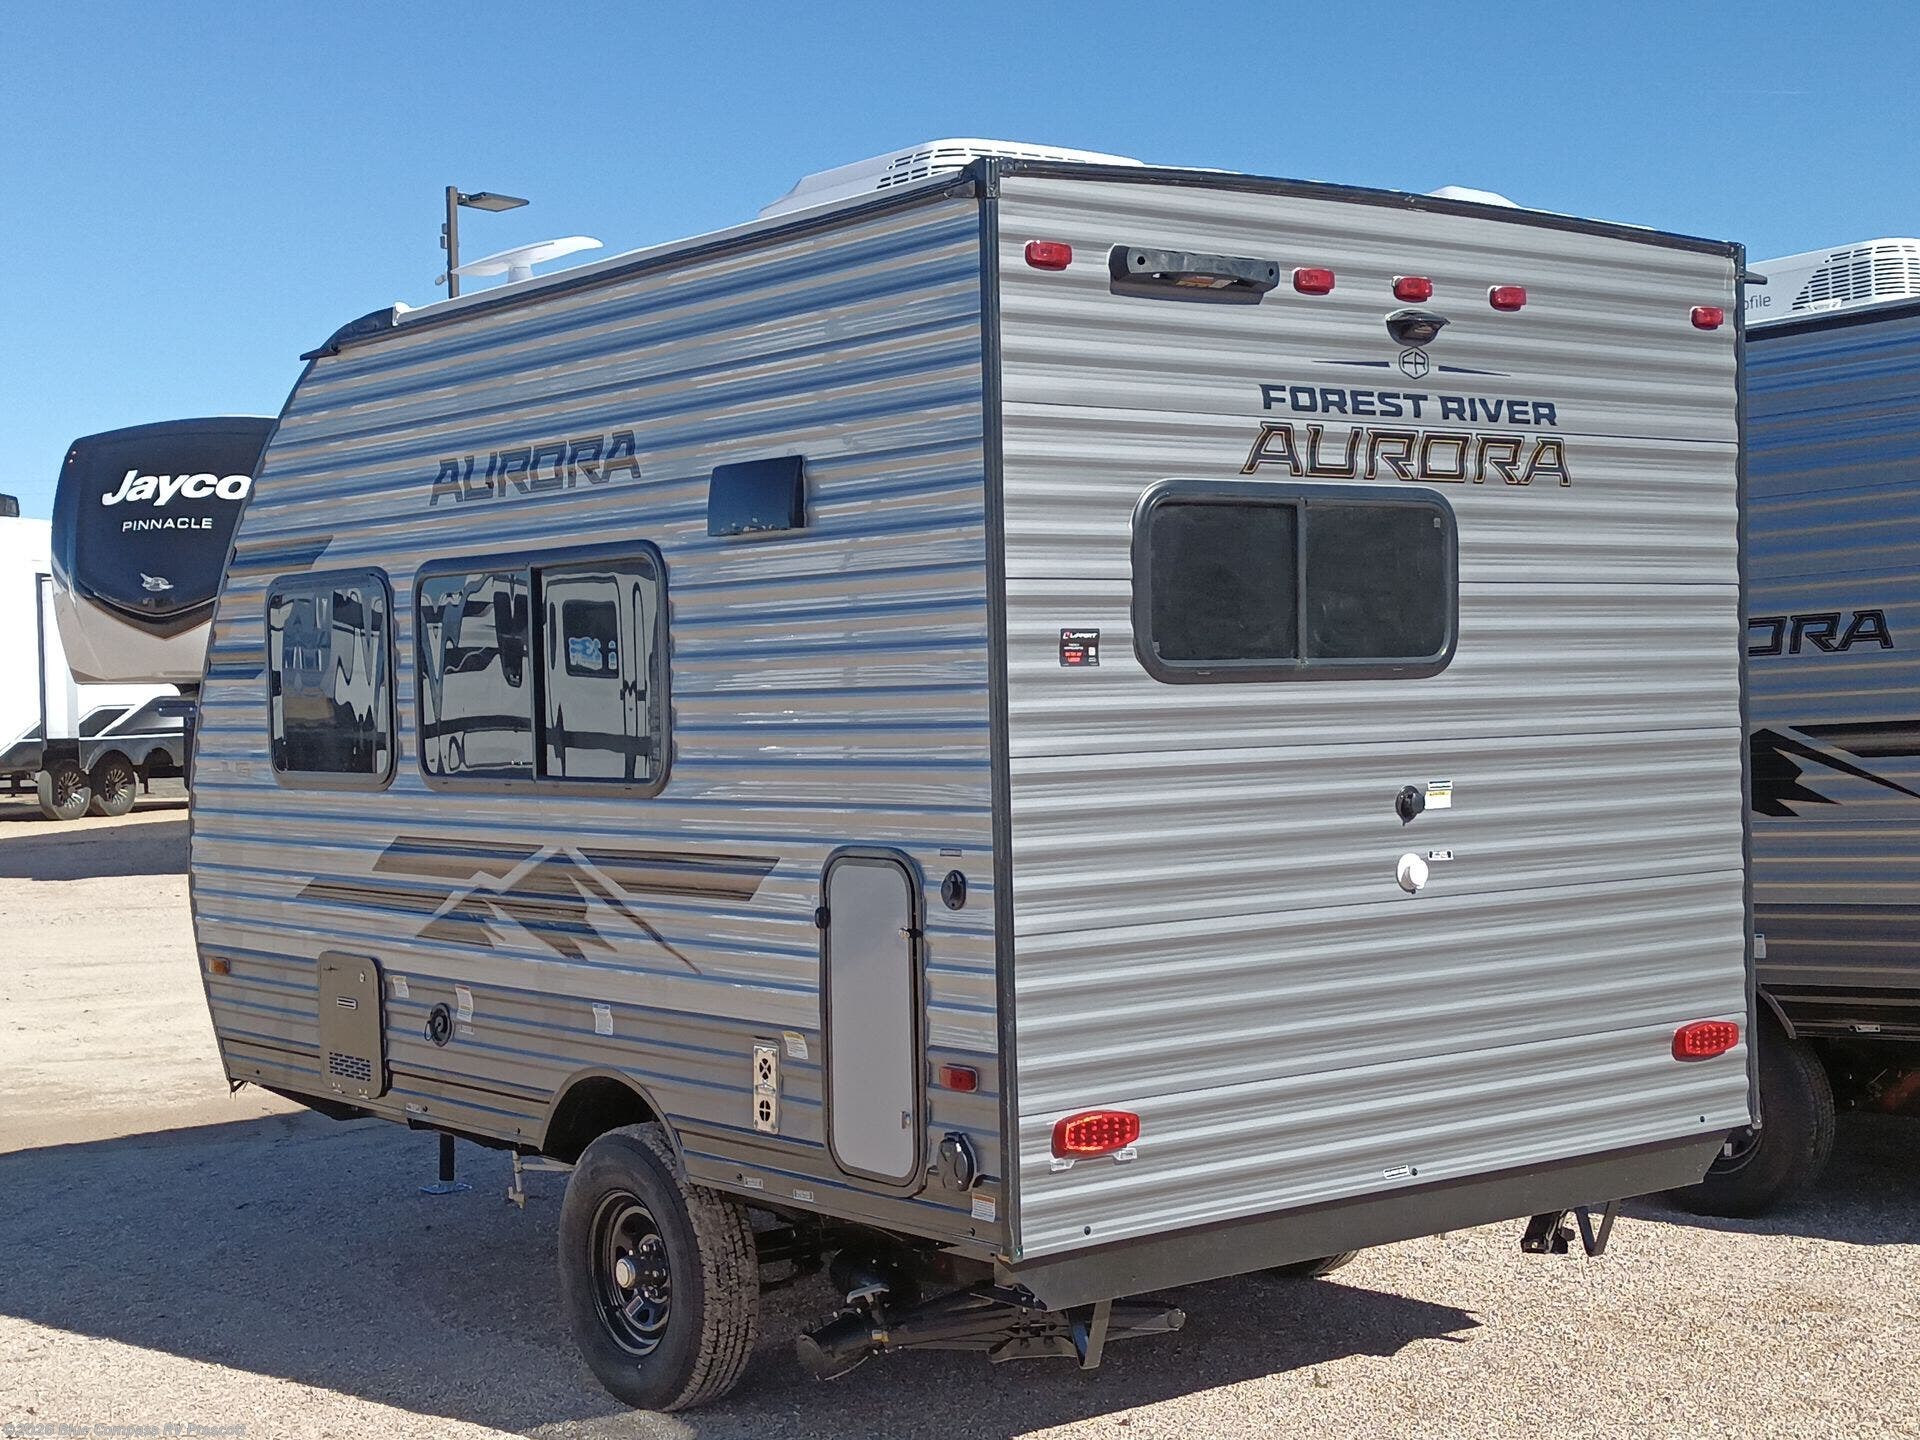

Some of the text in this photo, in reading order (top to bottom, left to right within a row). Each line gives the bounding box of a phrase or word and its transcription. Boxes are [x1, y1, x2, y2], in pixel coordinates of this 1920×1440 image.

[1259, 384, 1558, 427] FOREST RIVER
[429, 429, 642, 506] AURORA
[1239, 421, 1571, 488] AURORA
[102, 469, 252, 507] Jayco
[122, 517, 213, 533] PINNACLE
